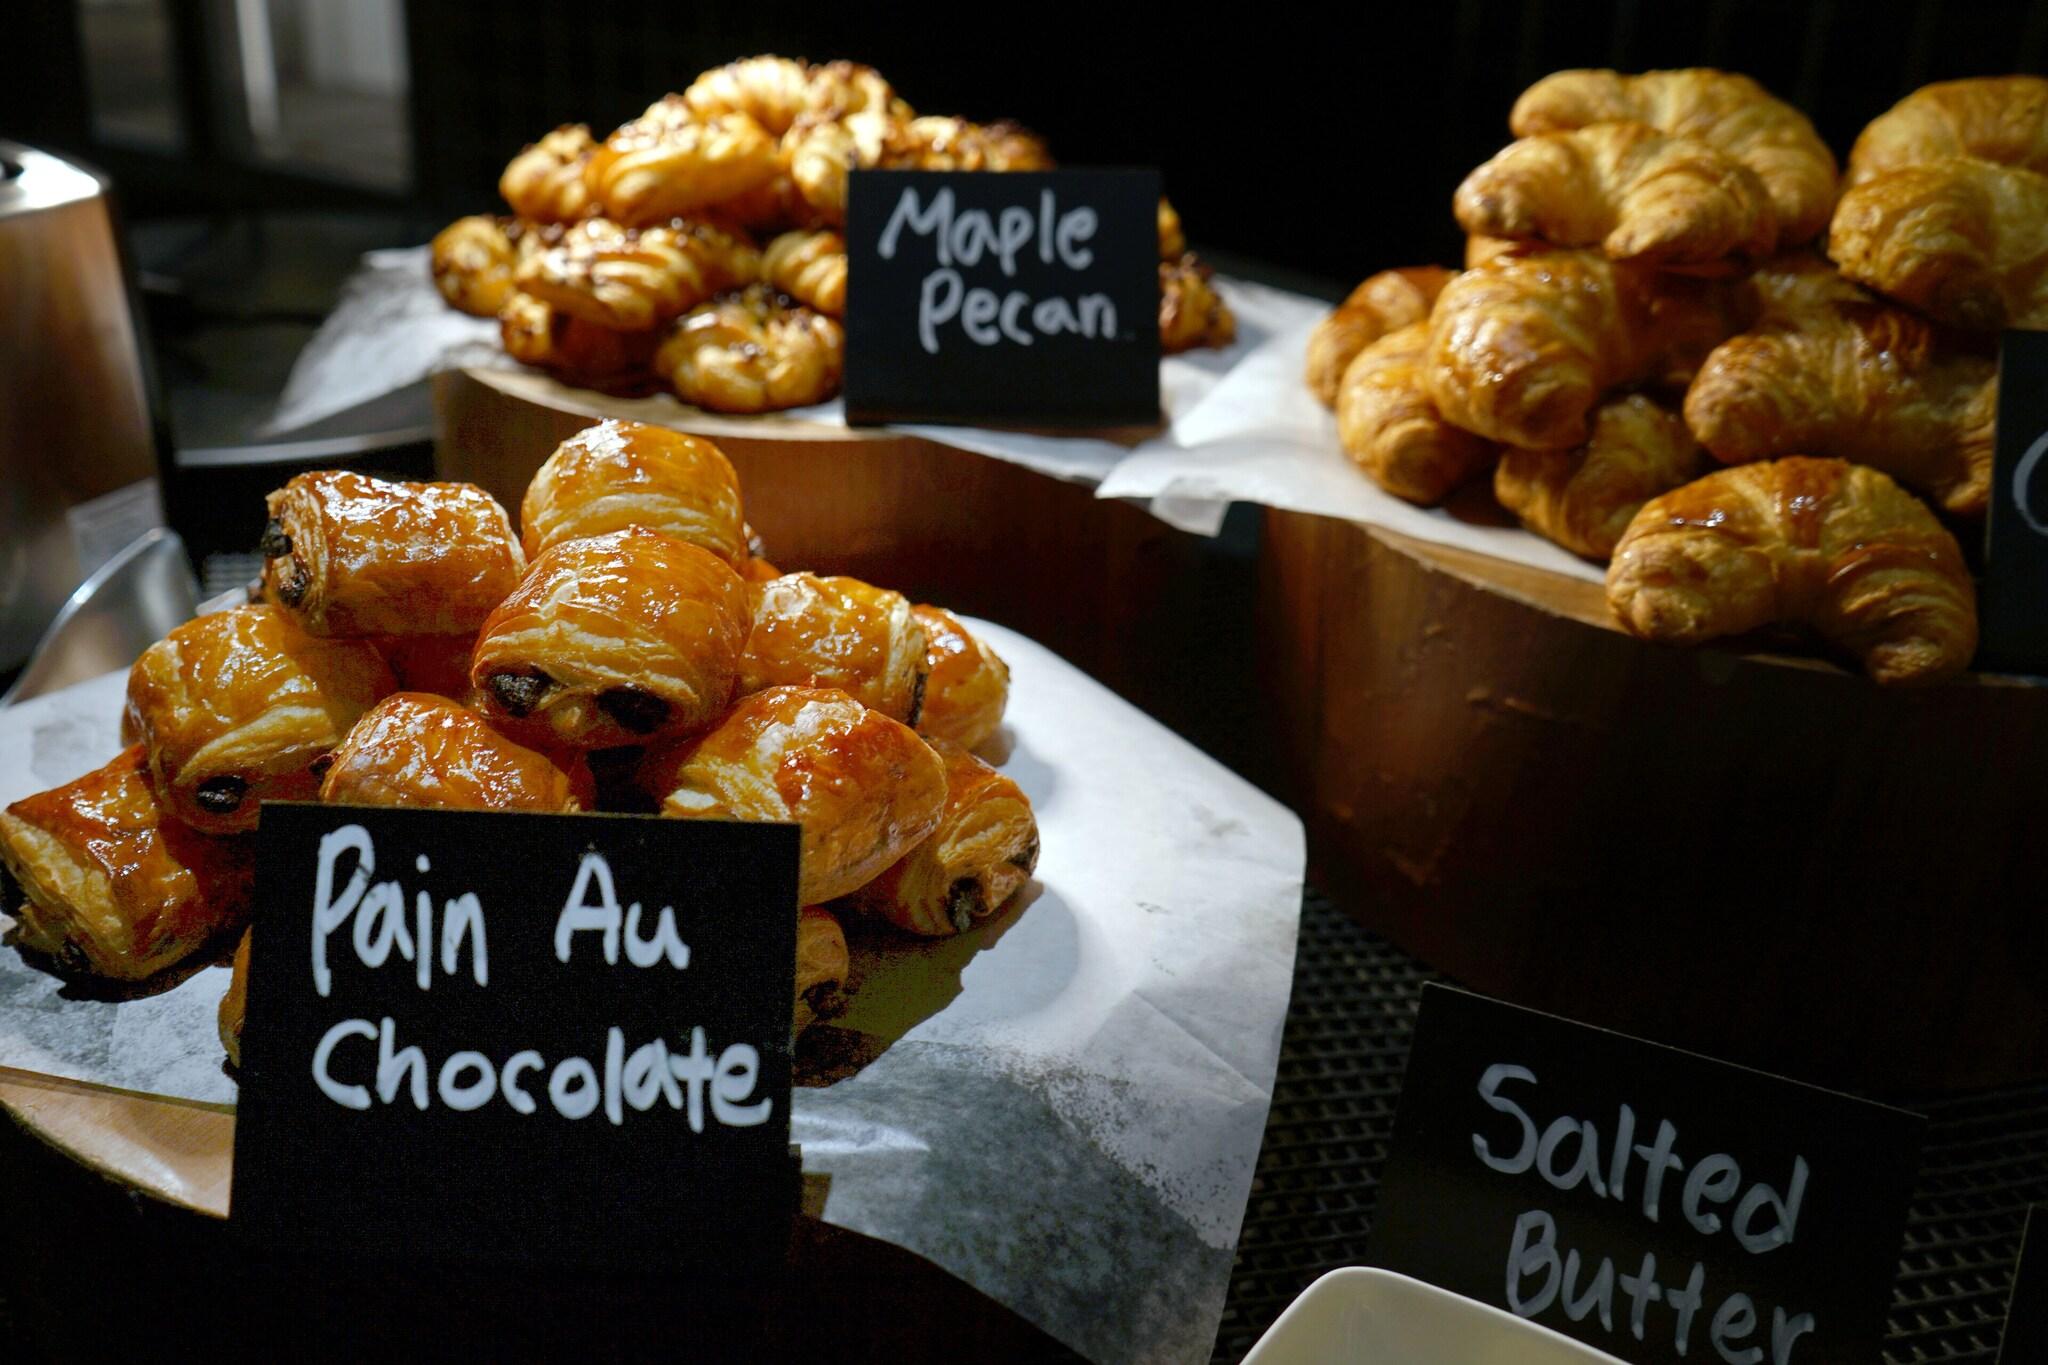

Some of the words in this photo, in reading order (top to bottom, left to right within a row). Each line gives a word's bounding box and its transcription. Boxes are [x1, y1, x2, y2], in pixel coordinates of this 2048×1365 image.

[876, 184, 1099, 279] Maple
[917, 266, 1120, 356] Pecan
[310, 823, 489, 998] Pain
[553, 850, 692, 971] Au
[310, 1015, 774, 1134] Chocolate
[1471, 1062, 1810, 1256] Salted
[1505, 1209, 1815, 1365] Butter
